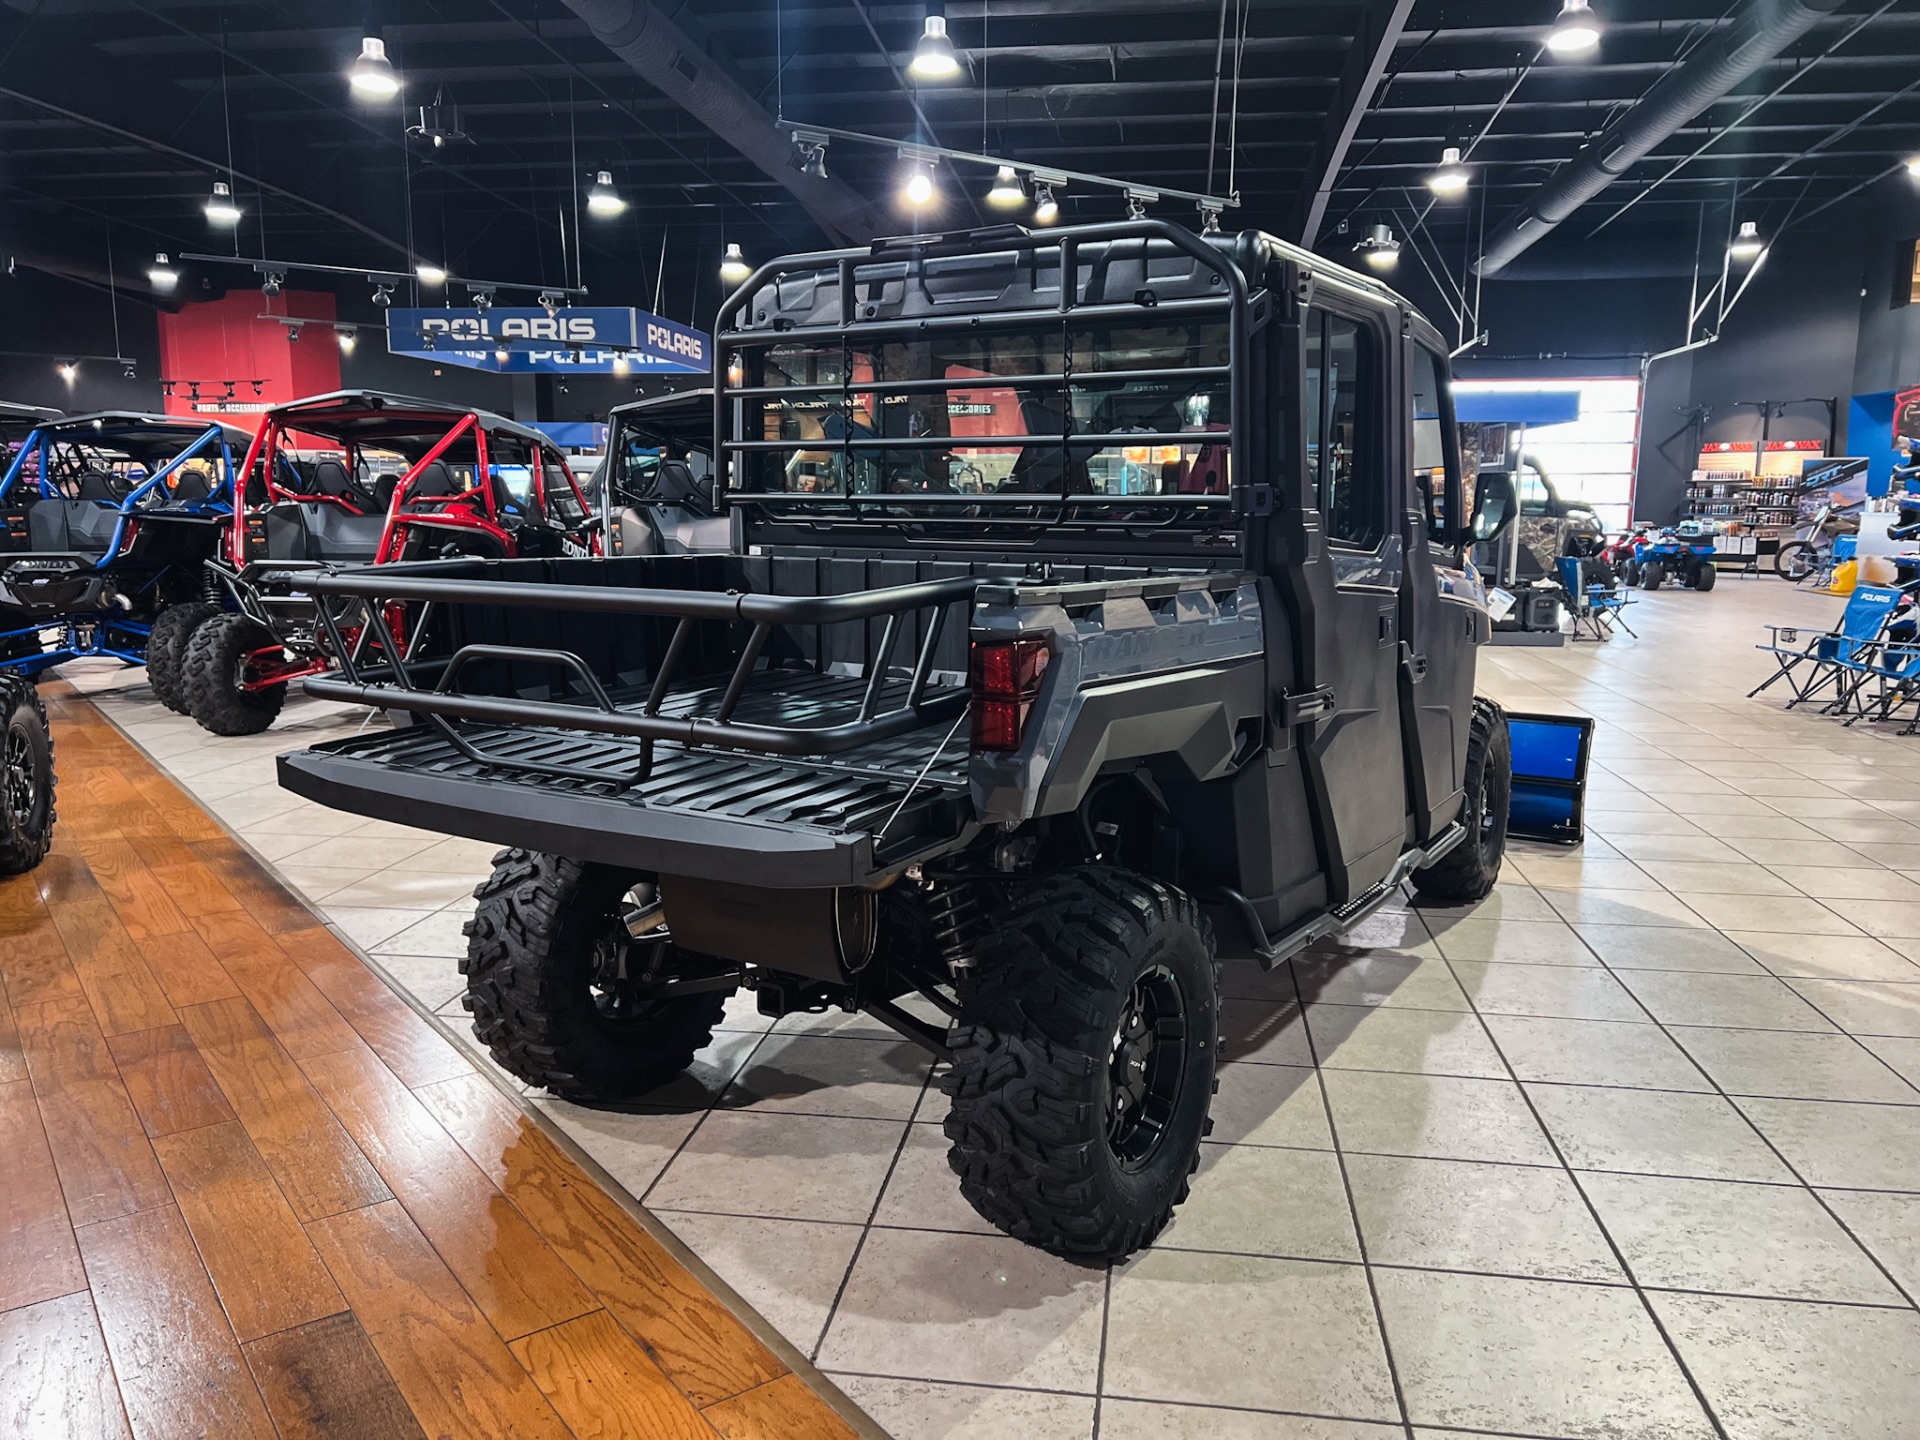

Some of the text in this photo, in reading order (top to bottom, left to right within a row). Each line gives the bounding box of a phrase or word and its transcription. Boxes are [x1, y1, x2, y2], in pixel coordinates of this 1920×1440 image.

[423, 318, 596, 341] POLARIS
[647, 323, 703, 360] POLARIS
[529, 350, 672, 364] POLARI
[1795, 440, 1822, 450] WAX
[1861, 592, 1891, 603] POLARIS
[1093, 622, 1207, 660] RANGER
